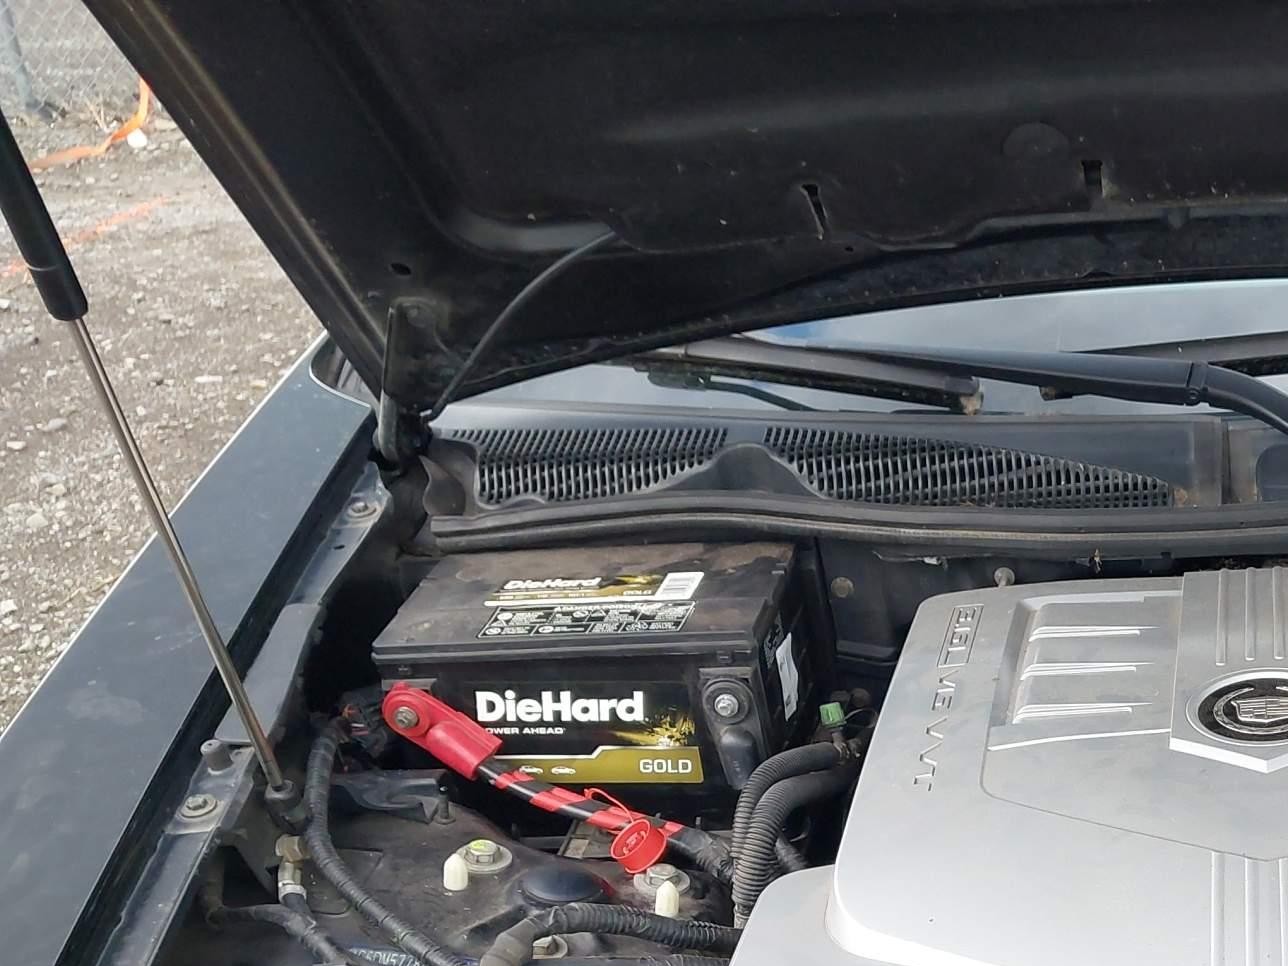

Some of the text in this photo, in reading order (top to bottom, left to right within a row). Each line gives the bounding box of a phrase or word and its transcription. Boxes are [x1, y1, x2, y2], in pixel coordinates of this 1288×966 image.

[504, 577, 602, 589] DieHard
[475, 690, 645, 722] DieHard
[485, 727, 520, 735] OWER
[639, 759, 693, 774] GOLD
